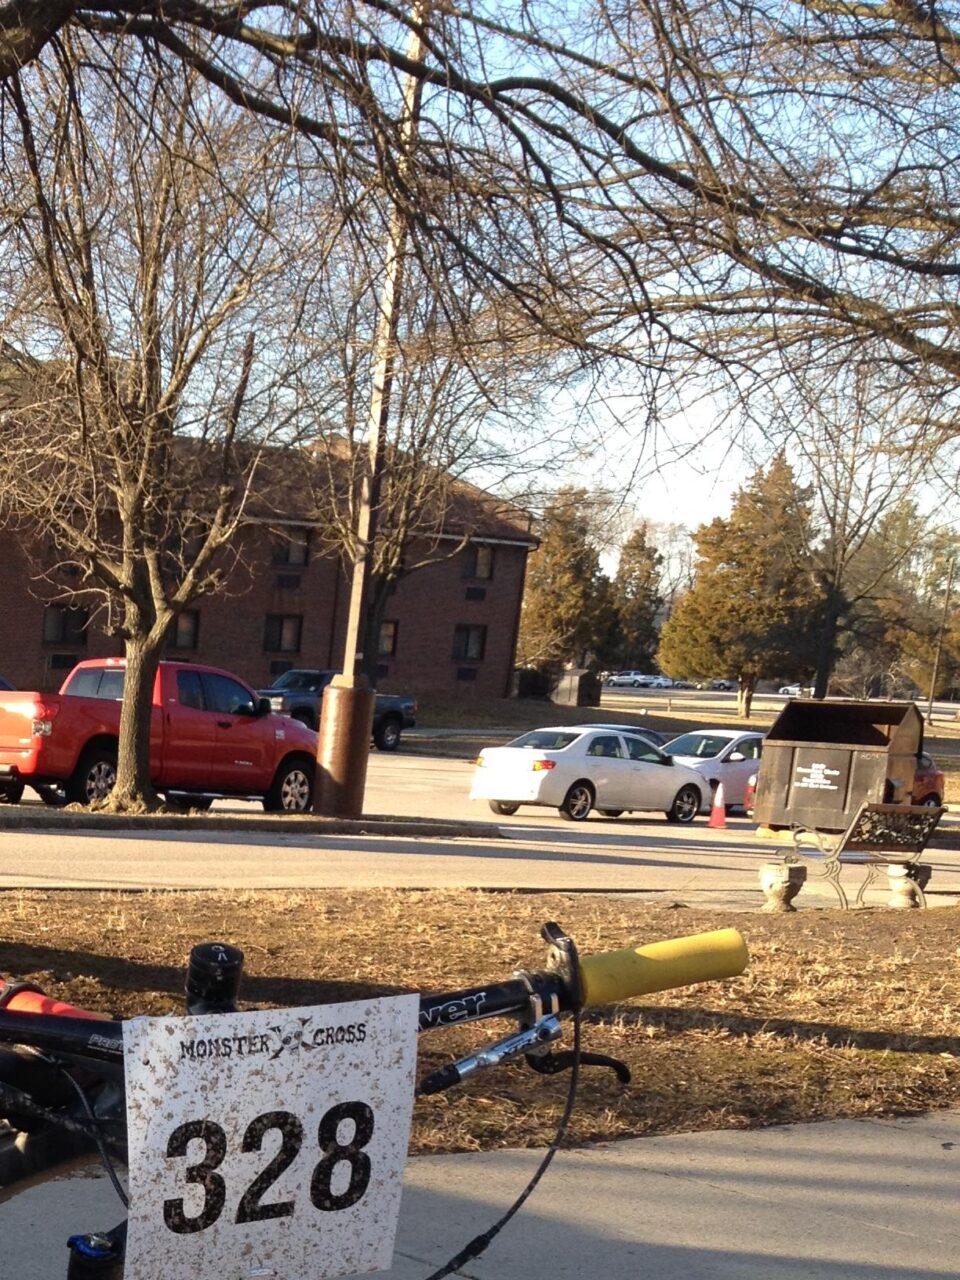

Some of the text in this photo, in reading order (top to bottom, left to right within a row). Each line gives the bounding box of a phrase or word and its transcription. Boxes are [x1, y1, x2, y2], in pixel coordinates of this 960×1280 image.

[179, 1023, 367, 1059] MONSTER CROSS
[162, 1100, 375, 1234] 328
